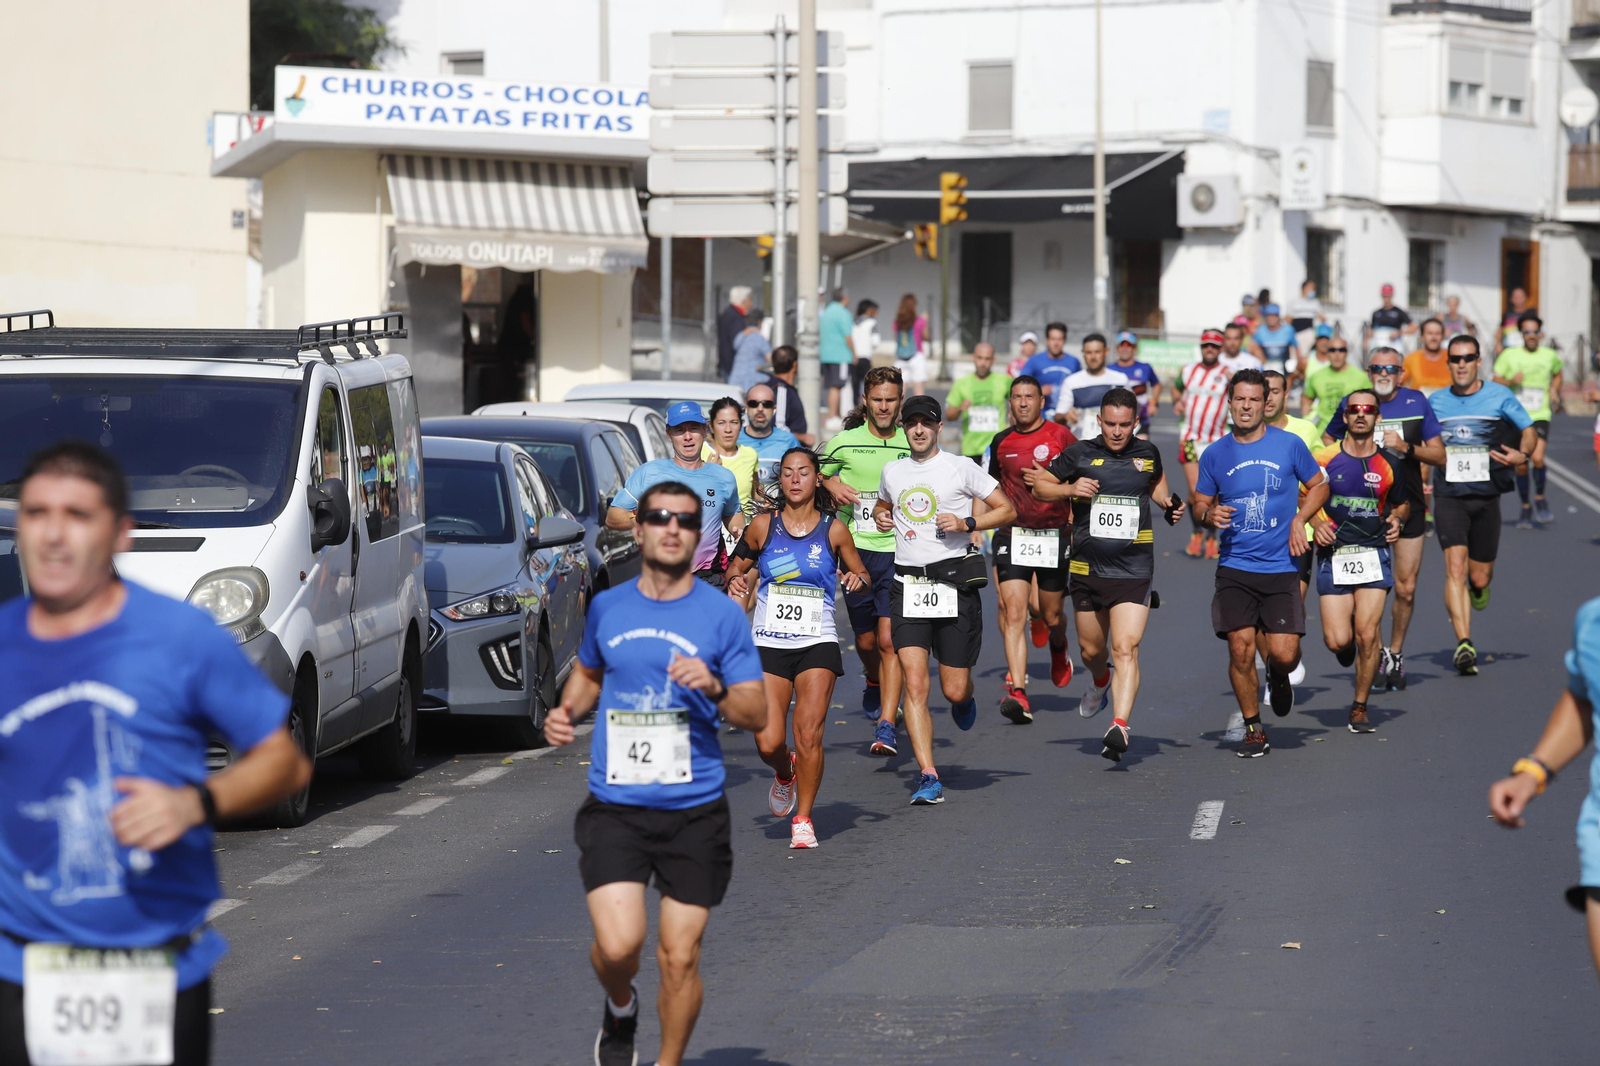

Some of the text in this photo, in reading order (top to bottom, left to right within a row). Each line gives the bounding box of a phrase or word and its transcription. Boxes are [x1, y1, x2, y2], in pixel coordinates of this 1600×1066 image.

[321, 76, 474, 100] CHURROS
[365, 103, 633, 132] PATATAS FRITAS
[409, 242, 464, 260] TOLDOS
[467, 241, 554, 264] ONUTAPI
[1457, 460, 1471, 472] 84
[1366, 474, 1379, 482] KIA
[1101, 497, 1117, 505] VUELTA
[862, 507, 874, 521] 6
[1098, 512, 1123, 527] 605
[1020, 543, 1042, 556] 254
[1341, 560, 1364, 575] 423
[779, 586, 797, 595] VUELTA
[802, 588, 820, 598] HUELVA
[913, 592, 938, 607] 340
[776, 603, 802, 621] 329
[627, 741, 652, 764] 42
[54, 994, 122, 1034] 509
